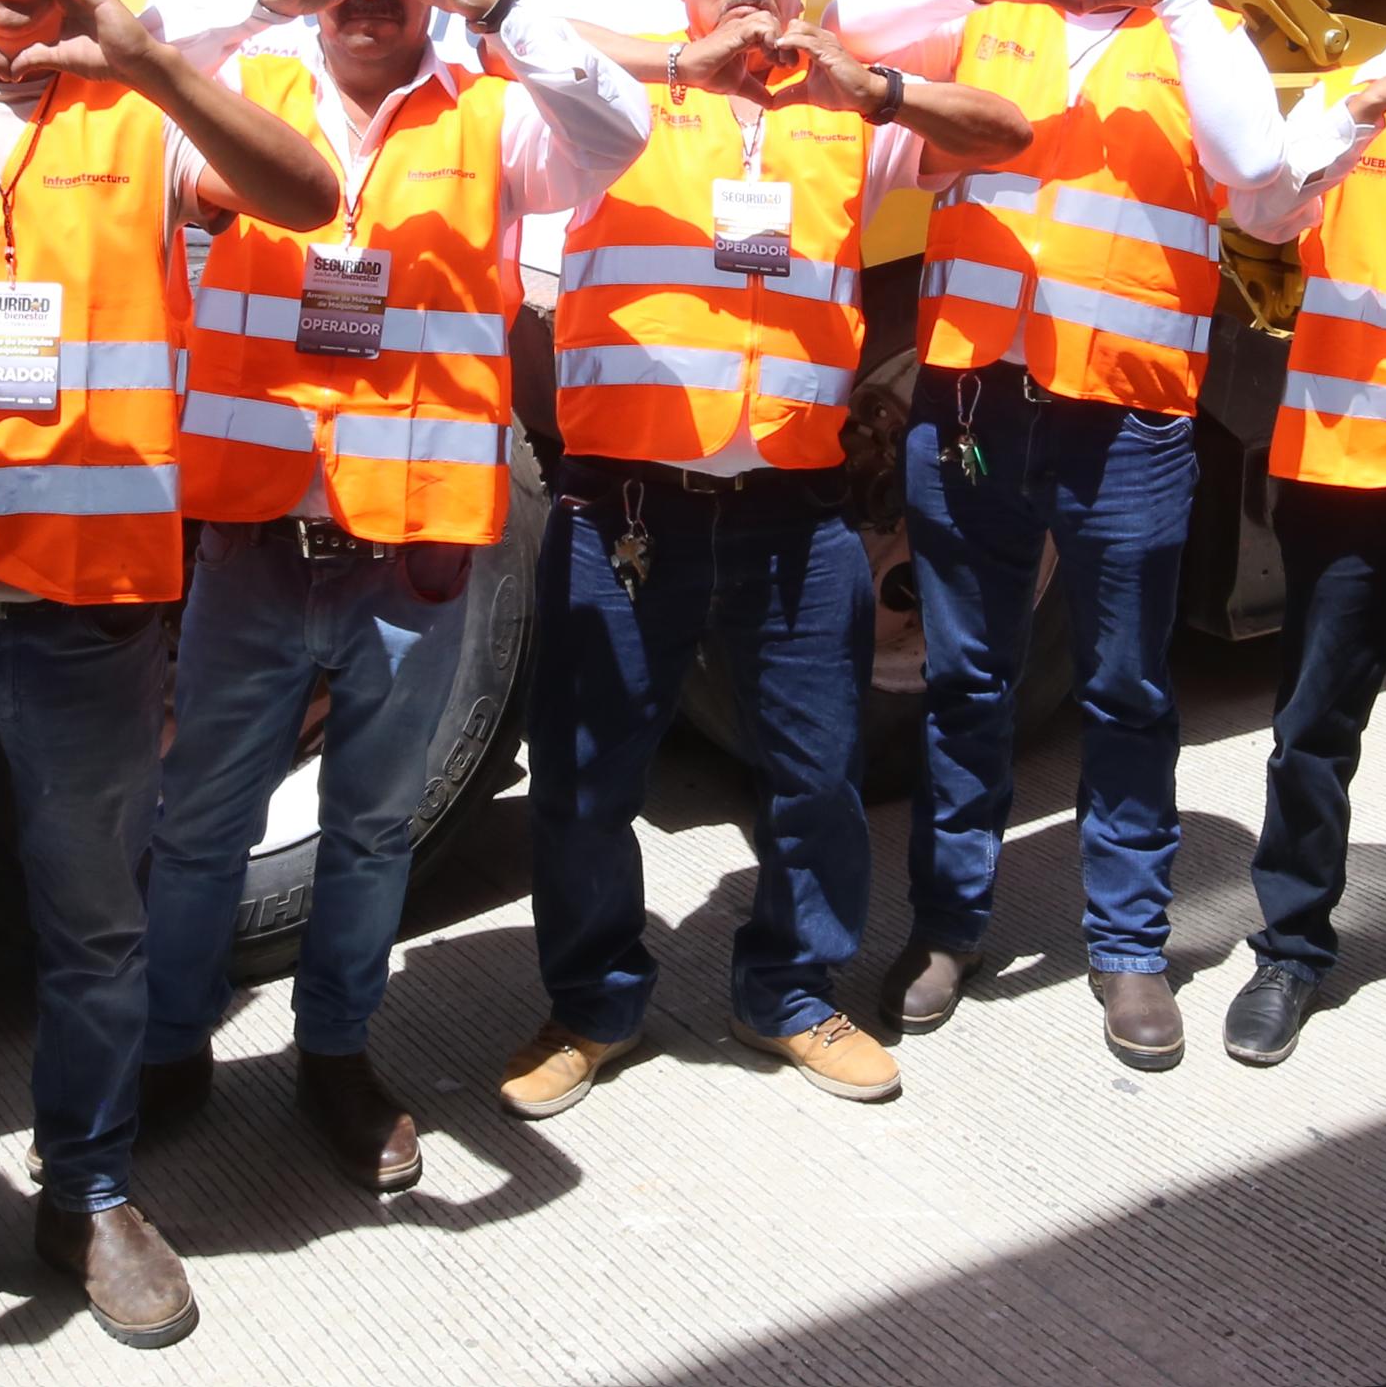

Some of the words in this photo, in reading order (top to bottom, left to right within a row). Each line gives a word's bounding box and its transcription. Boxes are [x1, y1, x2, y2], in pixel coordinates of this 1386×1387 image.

[42, 173, 130, 186] Infraestructura
[715, 240, 788, 256] OPERADOR
[314, 257, 381, 276] SEGURIDAD
[4, 312, 48, 320] bienestar
[301, 317, 381, 335] OPERADOR
